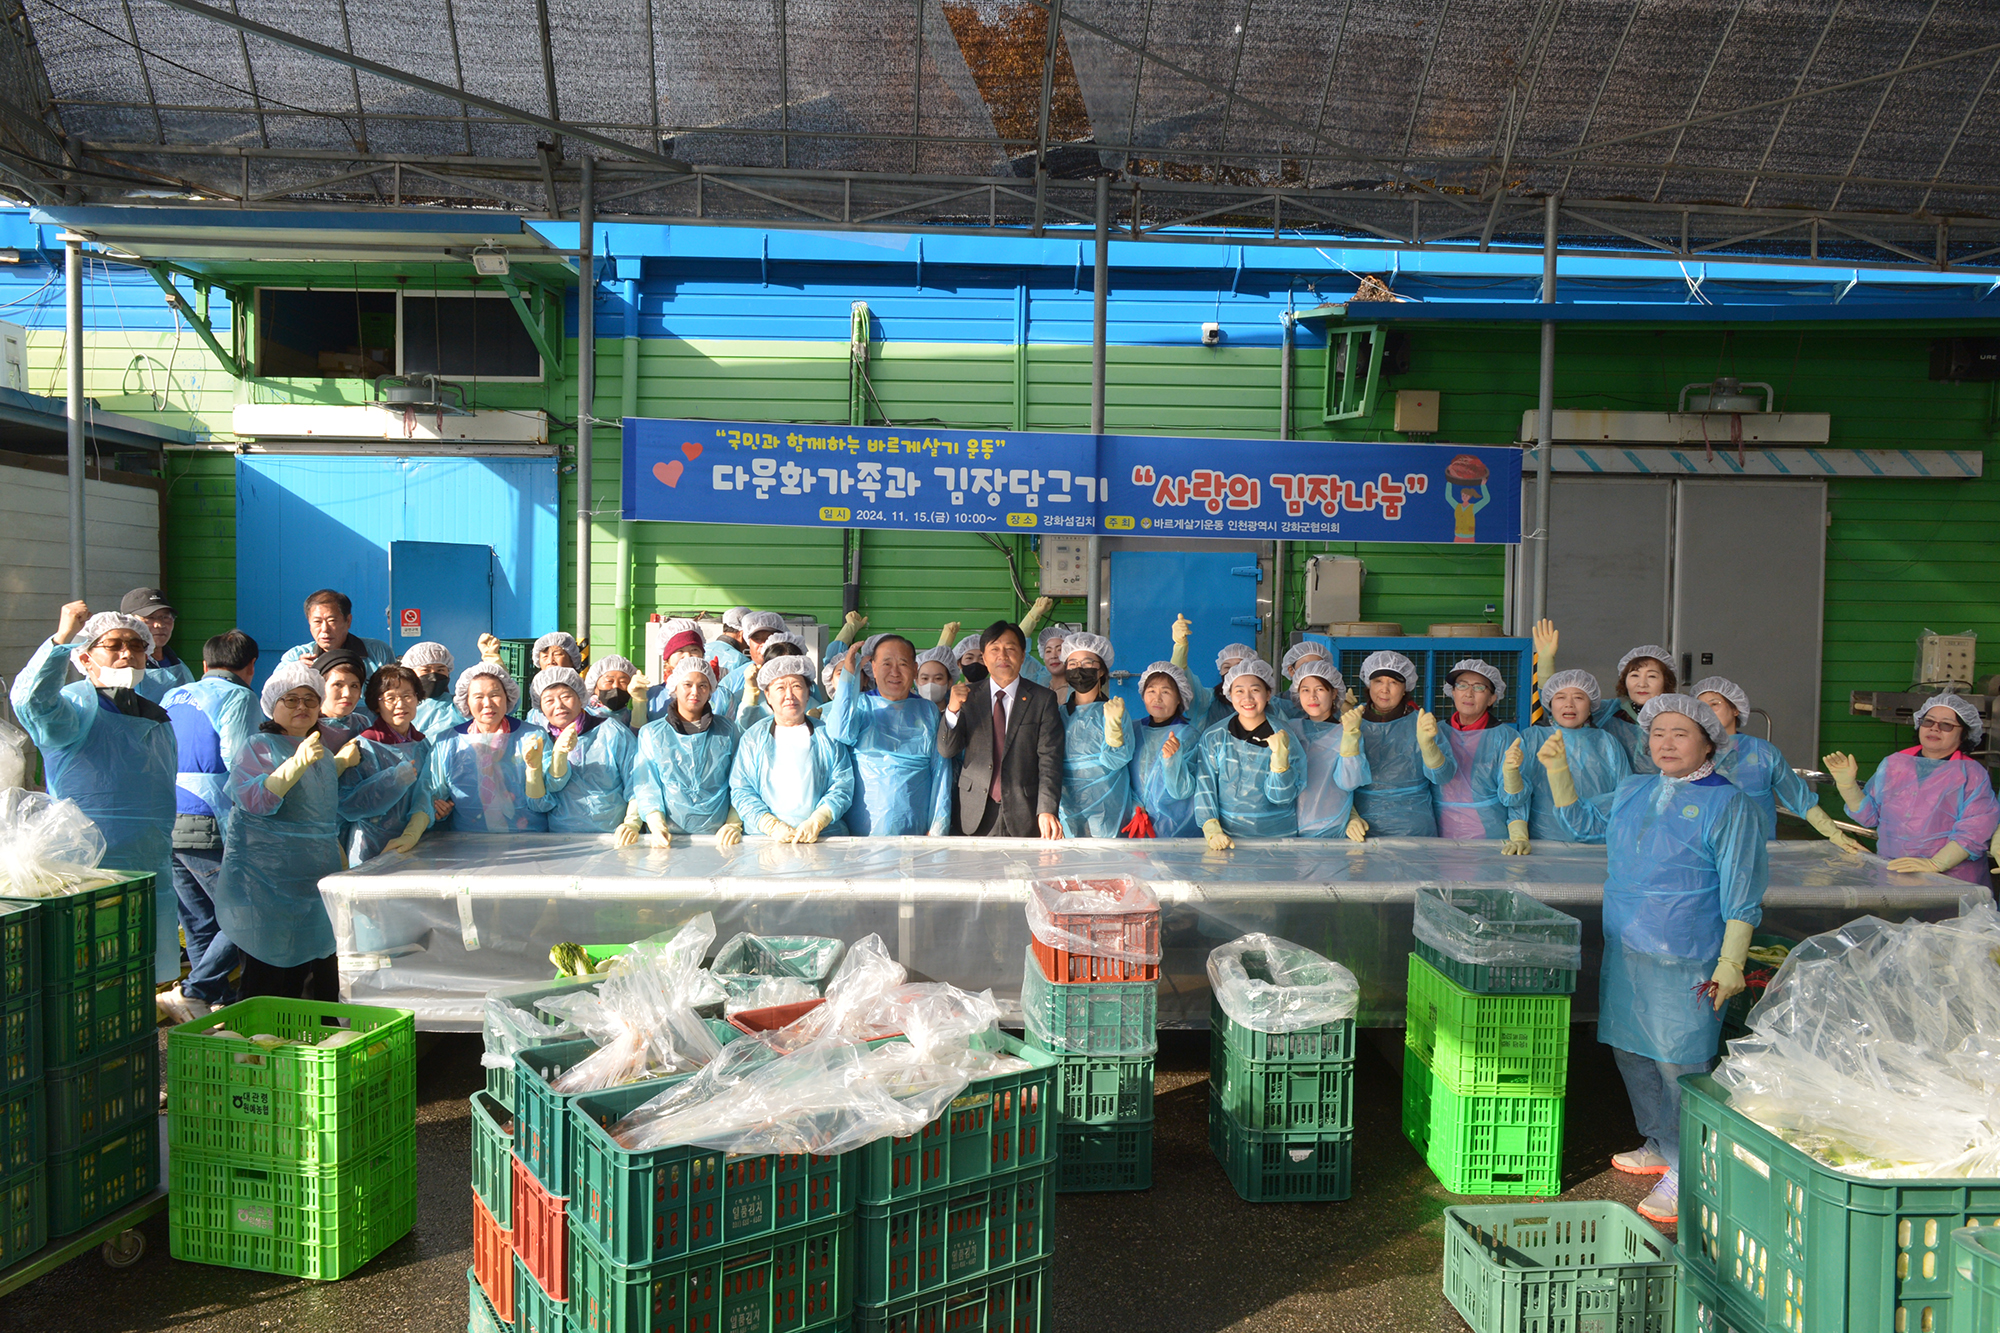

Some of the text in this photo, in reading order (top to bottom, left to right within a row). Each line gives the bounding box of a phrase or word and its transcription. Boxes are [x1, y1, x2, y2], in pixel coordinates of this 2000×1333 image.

[786, 432, 860, 455] 함께하는
[867, 437, 959, 457] 바르게살기
[712, 458, 1108, 508] 다문화가족과 김장담그기
[856, 509, 887, 521] 2024.
[892, 511, 909, 522] 11.
[913, 511, 950, 523] 15.(금)
[1043, 515, 1096, 527] 강화섬김치
[1153, 518, 1341, 533] 바르게살기운동 인천광역시 강화군협의회
[243, 1092, 268, 1104] 대관령
[732, 1201, 763, 1220] 일품김치
